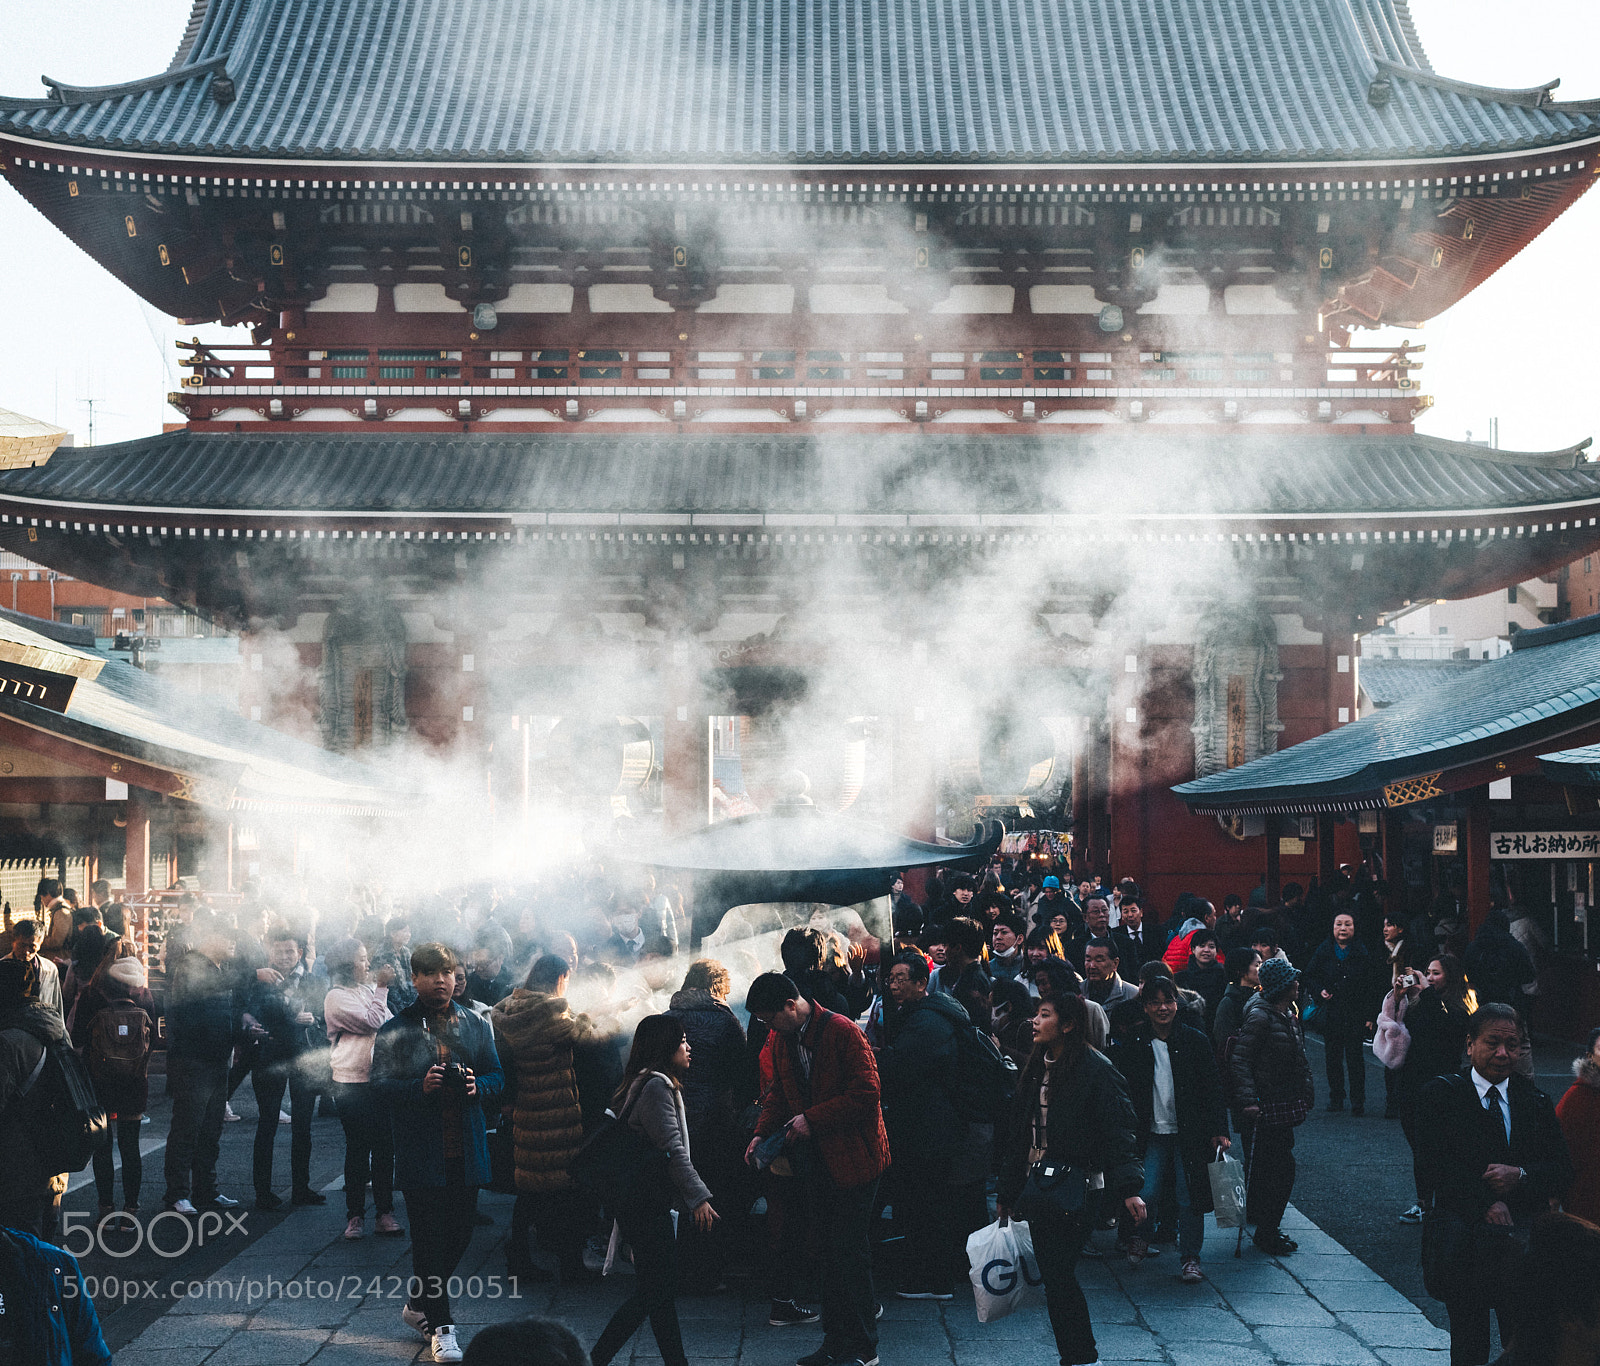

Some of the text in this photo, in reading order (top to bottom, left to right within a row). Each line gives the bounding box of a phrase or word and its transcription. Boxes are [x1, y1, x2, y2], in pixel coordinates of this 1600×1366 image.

[1495, 833, 1600, 854] 古札お納め所
